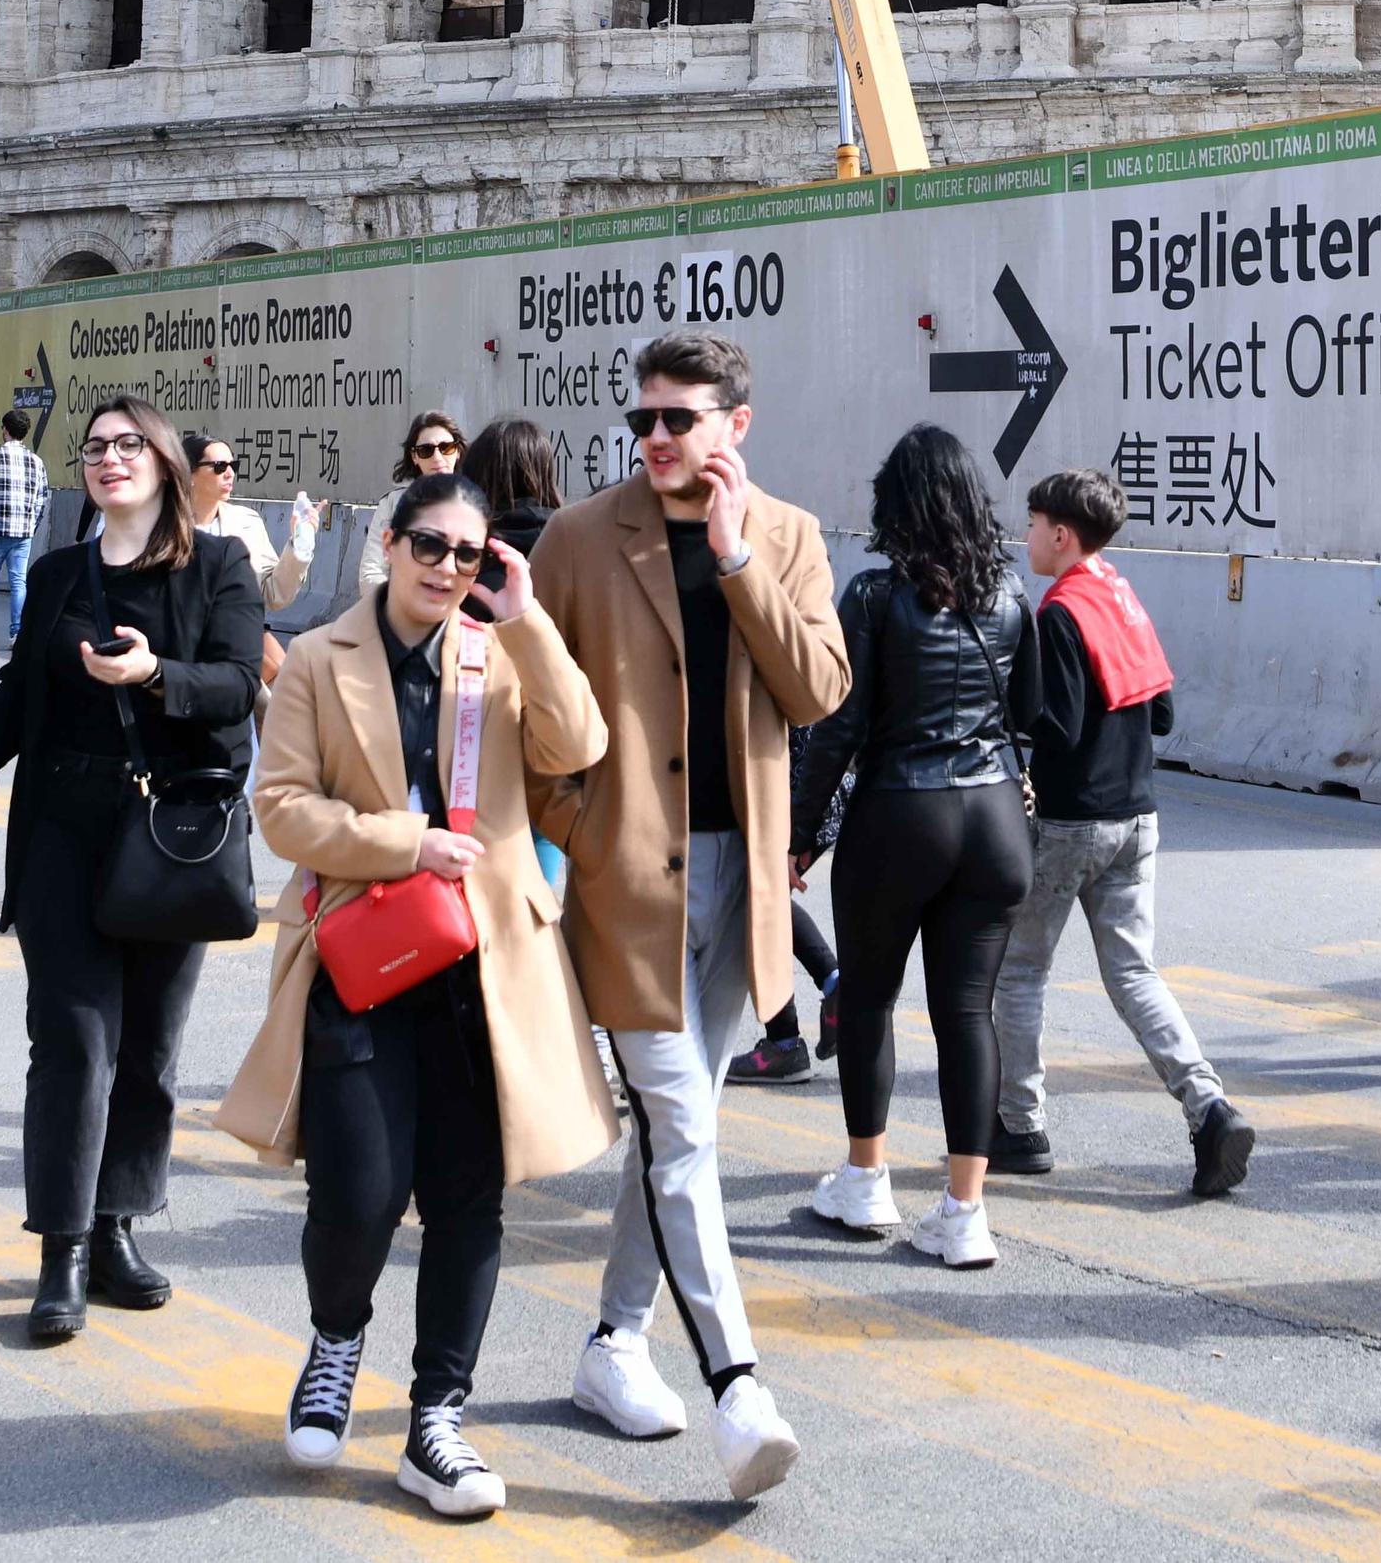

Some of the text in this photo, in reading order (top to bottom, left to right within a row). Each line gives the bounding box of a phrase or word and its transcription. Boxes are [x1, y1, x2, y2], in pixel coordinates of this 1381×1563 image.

[1106, 156, 1142, 179] LINEA
[1146, 154, 1154, 174] C
[1157, 150, 1196, 173] DELLA
[1199, 134, 1312, 168] METROPOLITANA
[1316, 132, 1331, 154] DI
[1335, 125, 1377, 151] ROMA
[697, 189, 875, 226] LINEA C DELLA METROPOLITANA DI ROMA
[914, 177, 964, 201] CANTIERE
[967, 173, 992, 194] FORI
[994, 167, 1051, 191] IMPERIALI
[429, 241, 446, 257] LINEA
[453, 238, 472, 254] DELLA
[472, 231, 526, 252] METROPOLITANA
[535, 228, 555, 245] ROMA
[577, 214, 669, 240] CANTIERE FORI IMPERIALI
[337, 249, 364, 266] CANTIERE
[379, 245, 408, 261] IMPERIALI
[519, 252, 785, 343] Biglietto € 16.00
[70, 299, 352, 360] Colosseo Palatino Foro Romano
[154, 368, 220, 412] Palatine
[225, 362, 253, 410] Hill
[258, 361, 326, 410] Roman
[333, 358, 403, 407] Forum
[518, 347, 629, 407] Ticket €
[1110, 321, 1267, 400] Ticket
[235, 427, 341, 486] 古罗马广场
[584, 434, 604, 492] €
[1110, 431, 1277, 529] 售票处
